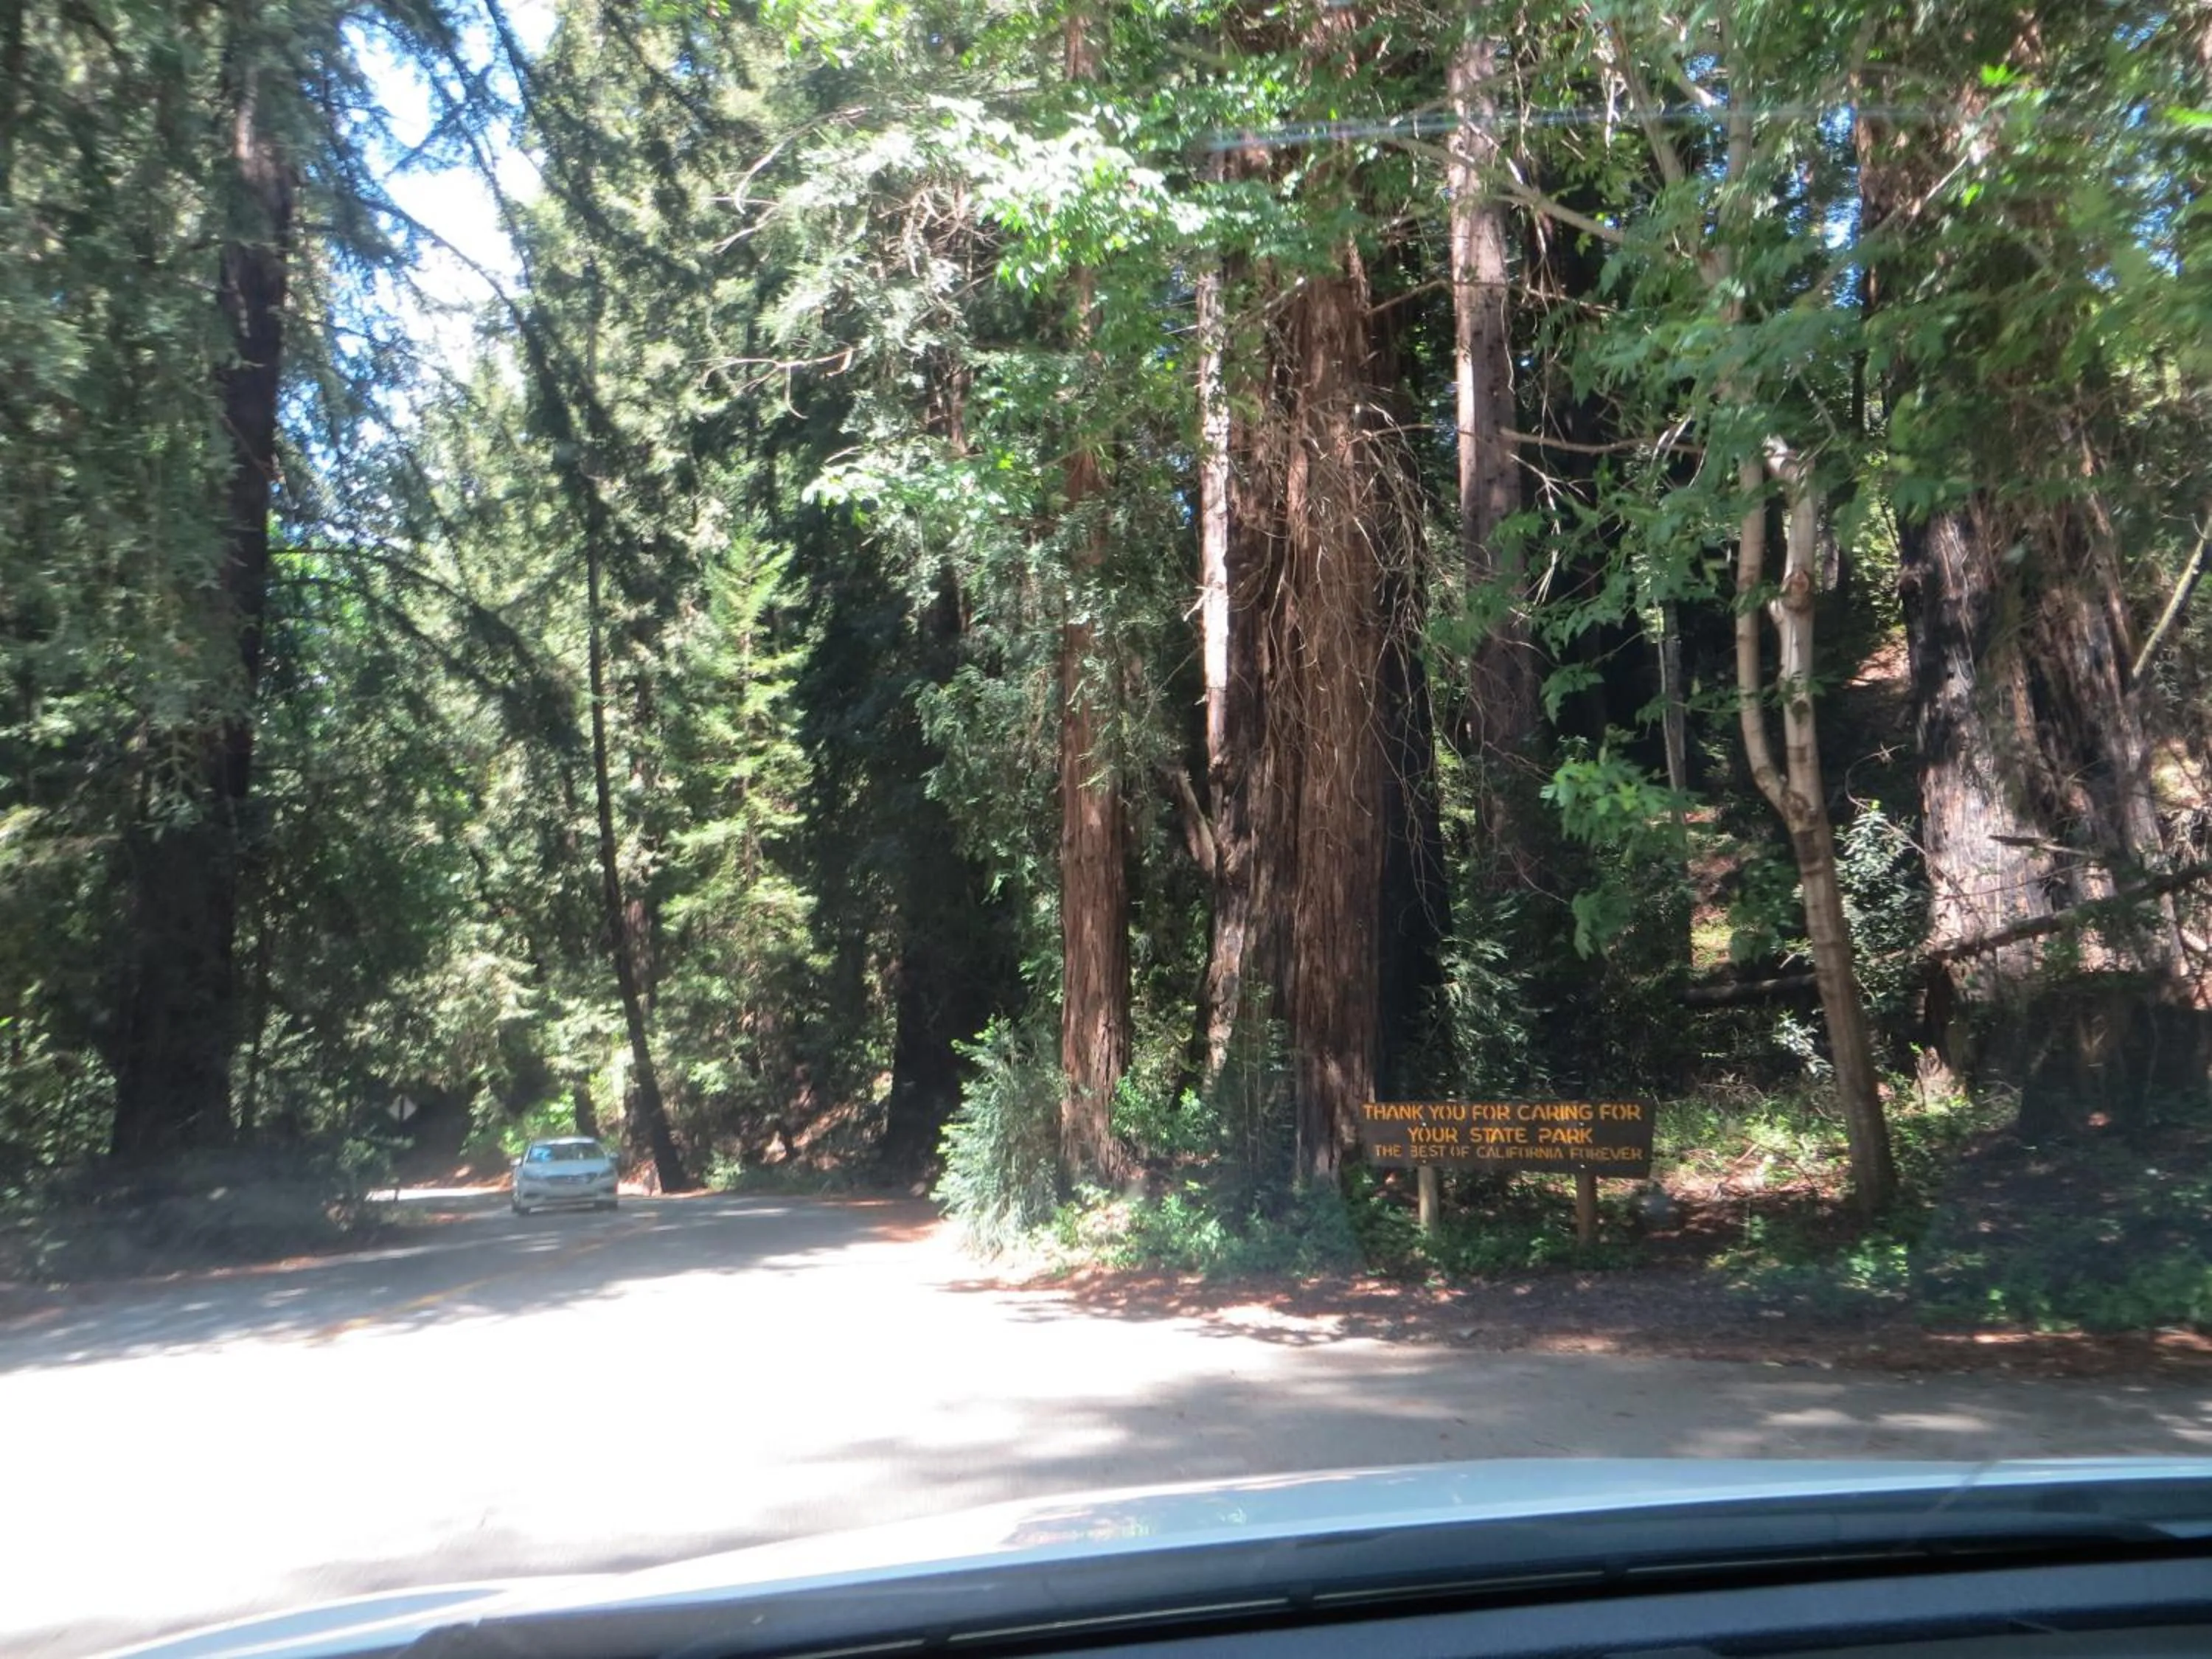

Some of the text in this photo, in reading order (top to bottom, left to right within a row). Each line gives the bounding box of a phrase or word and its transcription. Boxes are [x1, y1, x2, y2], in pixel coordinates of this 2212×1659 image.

[1363, 1105, 1641, 1121] THANK YOU FOR CARING FOR
[1408, 1127, 1593, 1144] YOUR STATE PARK
[1375, 1144, 1643, 1161] THE BEST OF CALIFORNIA FOREVER
